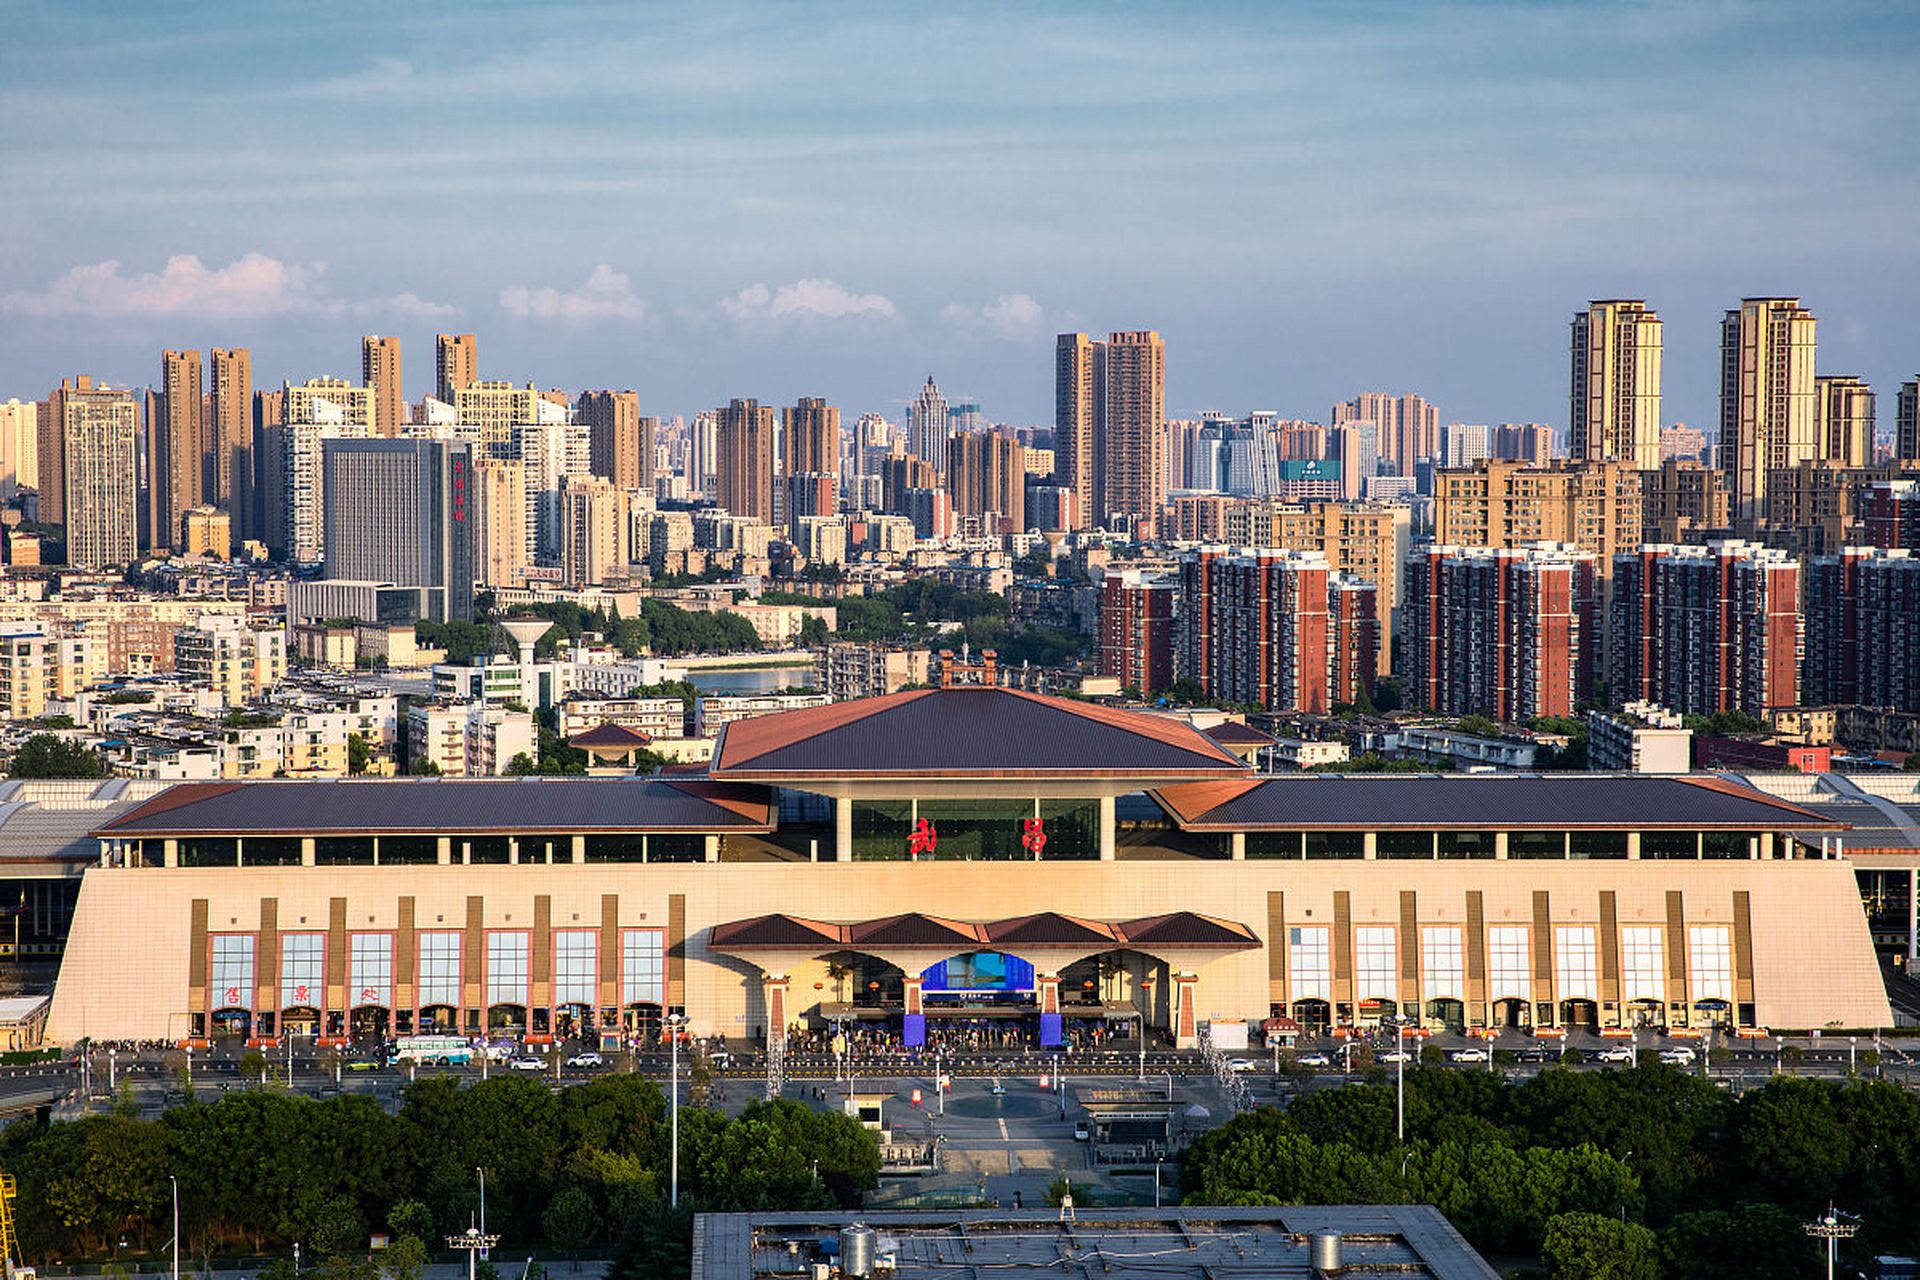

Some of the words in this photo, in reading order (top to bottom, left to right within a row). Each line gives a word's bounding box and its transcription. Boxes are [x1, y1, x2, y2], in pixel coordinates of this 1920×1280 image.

[907, 817, 1047, 854] 武昌
[225, 985, 379, 1004] 售票处
